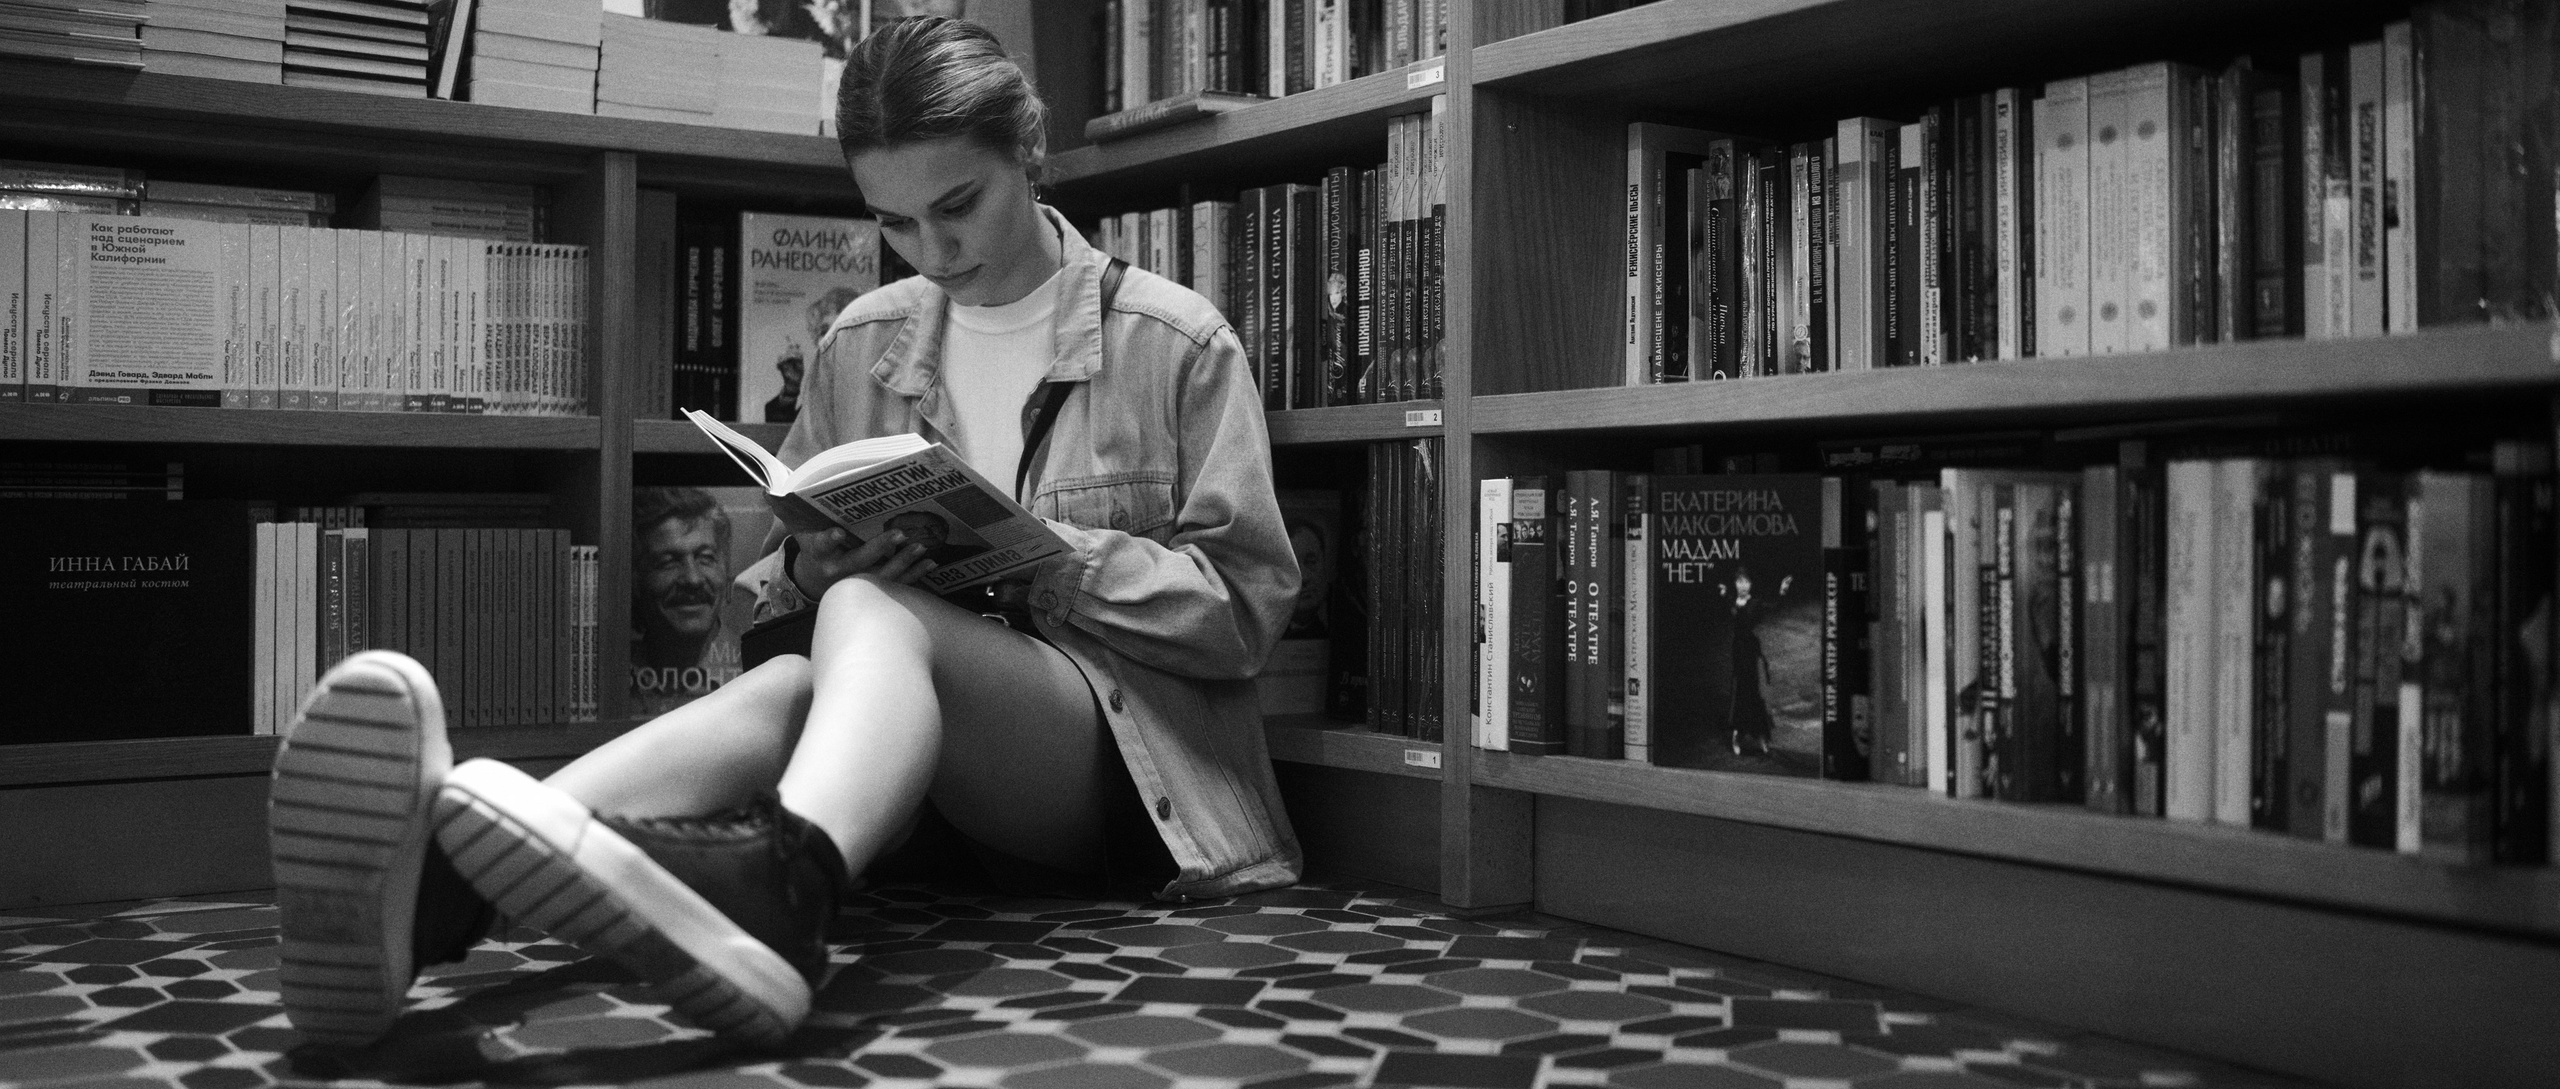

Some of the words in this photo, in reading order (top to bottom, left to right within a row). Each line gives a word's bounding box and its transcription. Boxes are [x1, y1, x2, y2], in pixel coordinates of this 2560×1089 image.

[1435, 70, 1440, 79] 3
[1810, 156, 1821, 194] ПРОШЛОГО
[1888, 147, 1897, 181] АКТЕРА
[1628, 184, 1639, 214] ПЬЕСЫ
[1811, 195, 1821, 206] ИЗ
[1889, 182, 1897, 242] ВОСПИТАНИЯ
[91, 223, 113, 233] Как
[118, 225, 174, 236] работают
[91, 235, 114, 244] над
[118, 236, 185, 247] сценарием
[773, 229, 851, 252] ФАИНА
[1330, 172, 1342, 273] АПЛОДИСМЕНТЫ
[91, 252, 166, 266] Калифорнии
[102, 243, 146, 254] Южной
[751, 248, 874, 275] РАНЕВСКАЯ
[1246, 212, 1254, 282] СТАРИКА
[1271, 207, 1281, 280] СТАРИКА
[1628, 214, 1639, 278] РЕЖИССЁРСКИЕ
[1812, 208, 1823, 287] НЕМИРОВИЧ-ДАНЧЕНКО
[1889, 243, 1897, 267] КУРС
[42, 293, 52, 338] Искусство
[1388, 286, 1396, 341] АЛЕКСАНДР
[1404, 285, 1412, 341] АЛЕКСАНДР
[1423, 284, 1431, 339] АЛЕКСАНДР
[1434, 272, 1442, 330] АЛЕКСАНДР
[1889, 267, 1898, 339] ПРАКТИЧЕСКИЙ
[1271, 286, 1281, 355] ВЕЛИКИХ
[1655, 310, 1663, 368] АВАНСЦЕНЕ
[1719, 303, 1729, 345] Письма
[1433, 413, 1438, 422] 2
[825, 460, 935, 509] ИННОКЕНТИЙ
[843, 468, 972, 521] СМОКТУНОВСКИЙ
[1661, 489, 1783, 512] ЕКАТЕРИНА
[1568, 496, 1578, 519] А.Я.
[1588, 496, 1598, 521] А.Я.
[1661, 513, 1799, 536] МАКСИМОВА
[49, 556, 117, 572] ИННА
[122, 553, 190, 572] ГАБАЙ
[1568, 521, 1578, 566] Таиров
[1588, 523, 1598, 568] Таиров
[1661, 539, 1739, 560] МАДАМ
[49, 579, 137, 591] театральный
[141, 581, 190, 589] костюм
[925, 566, 966, 587] Без
[964, 548, 1024, 575] грима
[1662, 562, 1714, 583] "НЕТ"
[1568, 579, 1578, 595] О
[1588, 581, 1598, 597] О
[1485, 581, 1494, 661] Станиславский
[1568, 597, 1578, 663] ТЕАТРЕ
[1588, 599, 1598, 666] ТЕАТРЕ
[1485, 664, 1494, 726] Константин
[1432, 756, 1436, 764] 1
